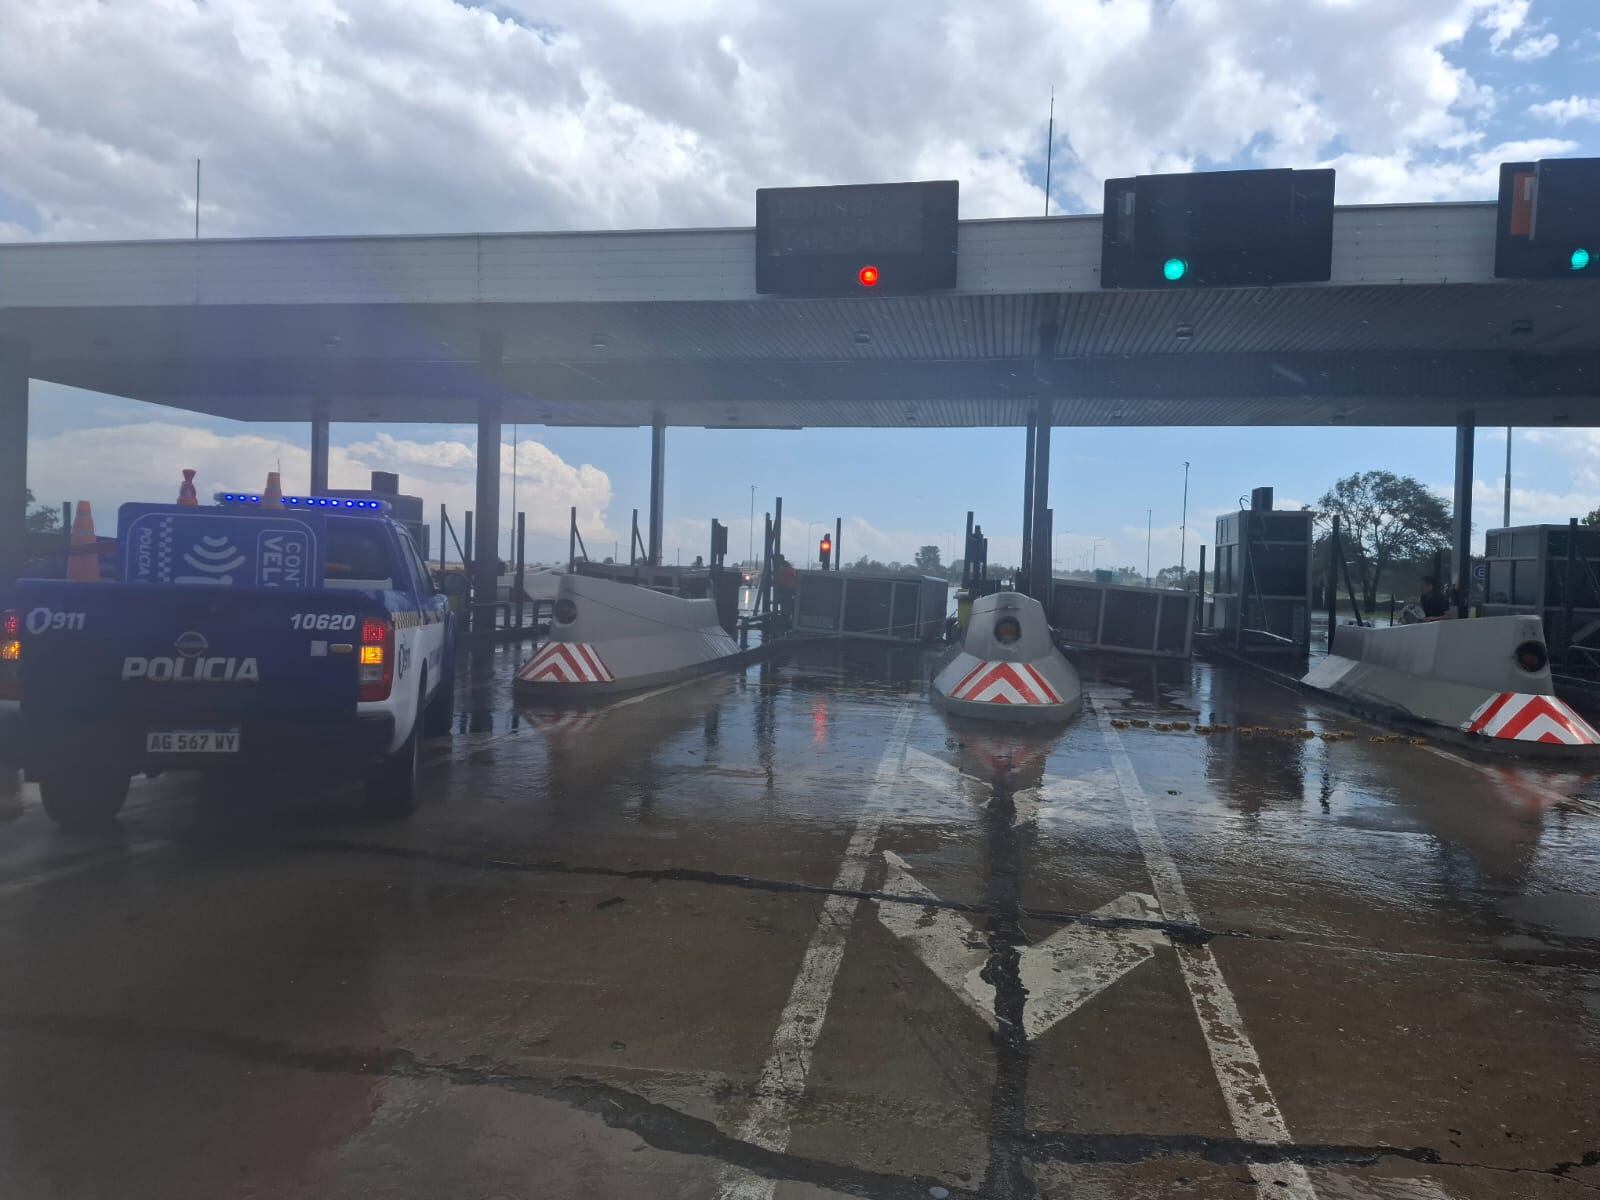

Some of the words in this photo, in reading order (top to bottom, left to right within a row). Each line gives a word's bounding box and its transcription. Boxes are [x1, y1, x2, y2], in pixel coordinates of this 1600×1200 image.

[137, 527, 152, 576] POLICIA
[262, 536, 284, 587] VEL
[285, 542, 301, 588] CON
[290, 613, 356, 631] 10620
[121, 656, 259, 682] POLICIA
[151, 735, 172, 750] AG
[177, 735, 209, 750] 567
[215, 735, 235, 750] WY
